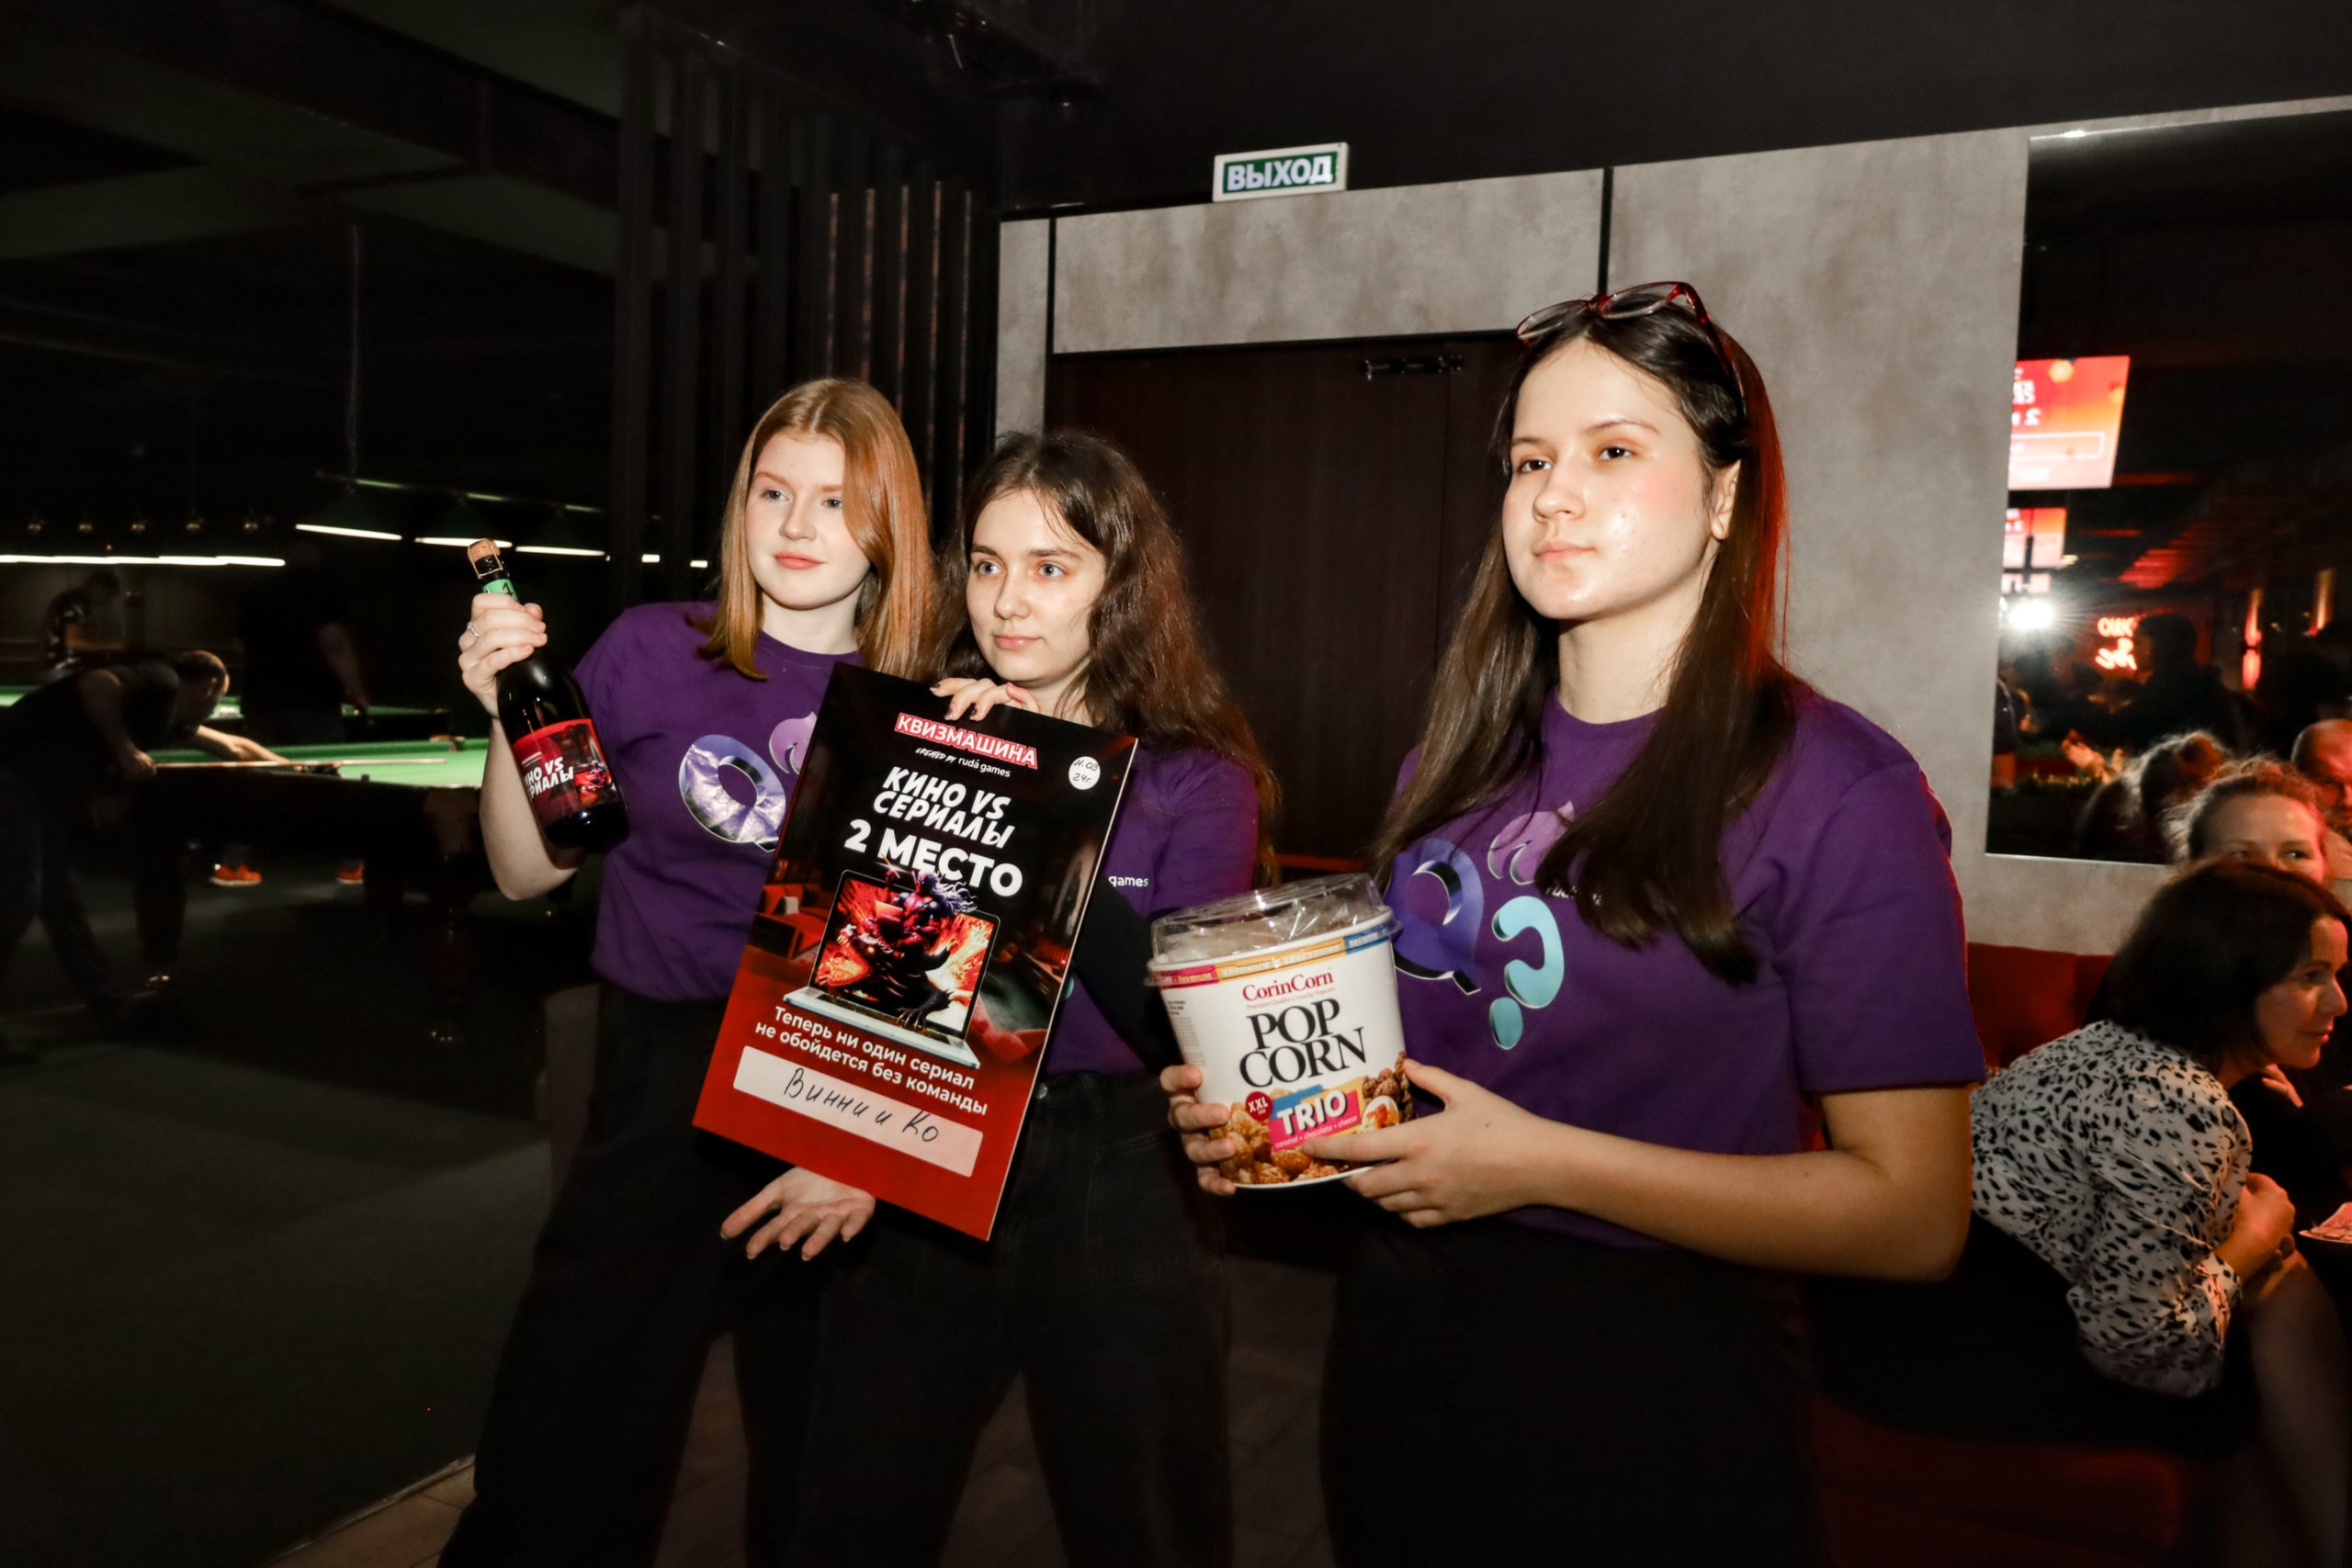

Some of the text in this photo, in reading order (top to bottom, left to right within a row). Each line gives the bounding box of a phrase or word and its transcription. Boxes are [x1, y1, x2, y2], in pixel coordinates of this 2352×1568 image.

[1227, 155, 1333, 191] ВЫХОД
[544, 756, 564, 775] VS
[896, 714, 1037, 768] КВИЗМАШИНА
[915, 747, 946, 761] CREATED
[944, 754, 957, 764] BY
[979, 762, 1012, 778] games
[882, 766, 1012, 820] КИНО VS
[873, 790, 1015, 850] СЕРИАЛЫ
[844, 818, 1023, 897] 2 МЕСТО
[1108, 875, 1148, 888] games
[1242, 972, 1334, 1001] CorinCorn
[775, 1005, 975, 1090] Теперь ни один сериал
[1246, 998, 1340, 1051] POP
[754, 1021, 989, 1116] не обойдется без команды
[1239, 1026, 1367, 1089] CORN
[784, 1066, 940, 1144] Винни и Ко
[1248, 1096, 1269, 1113] XXL
[1276, 1089, 1347, 1135] TRIO
